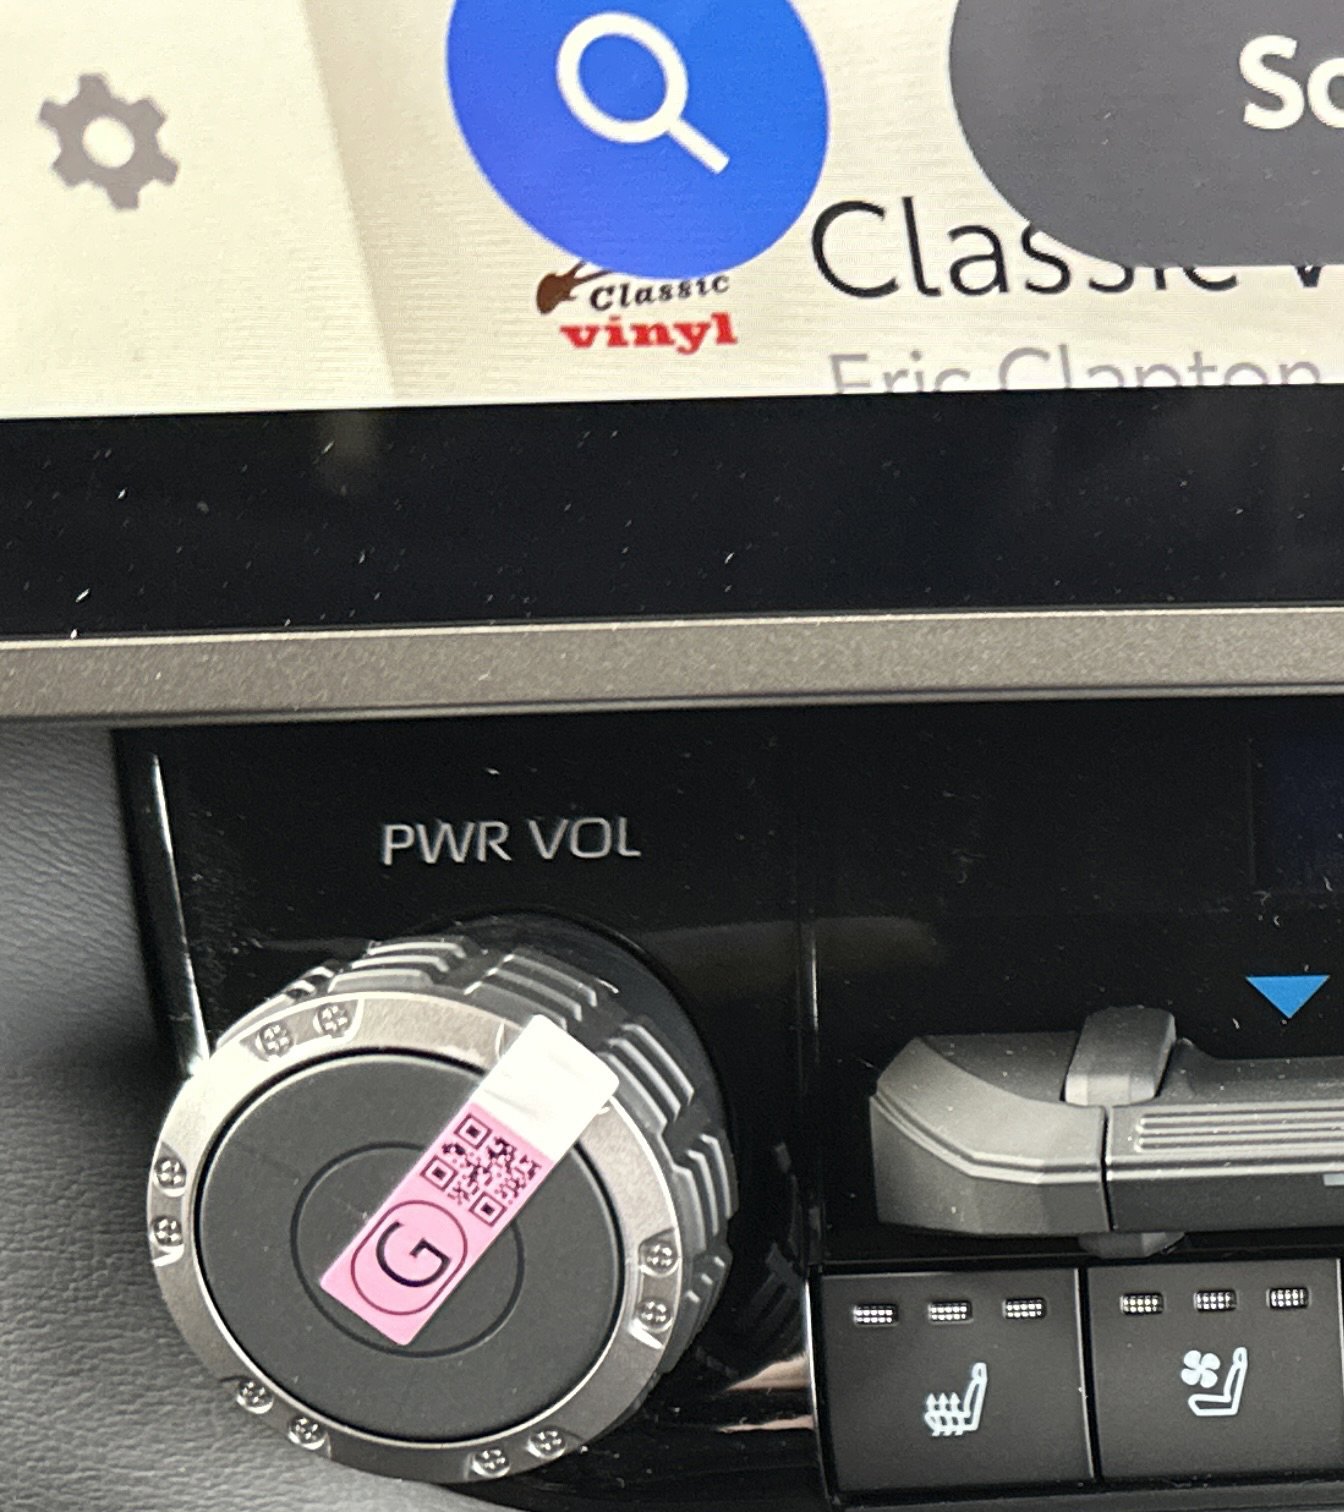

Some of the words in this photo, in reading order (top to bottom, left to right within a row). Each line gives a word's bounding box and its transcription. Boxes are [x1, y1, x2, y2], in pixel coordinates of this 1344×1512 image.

[588, 274, 730, 312] Classic
[559, 311, 738, 355] vinyl
[381, 819, 512, 866] PWR
[528, 815, 642, 860] VOL
[374, 1220, 452, 1289] G
